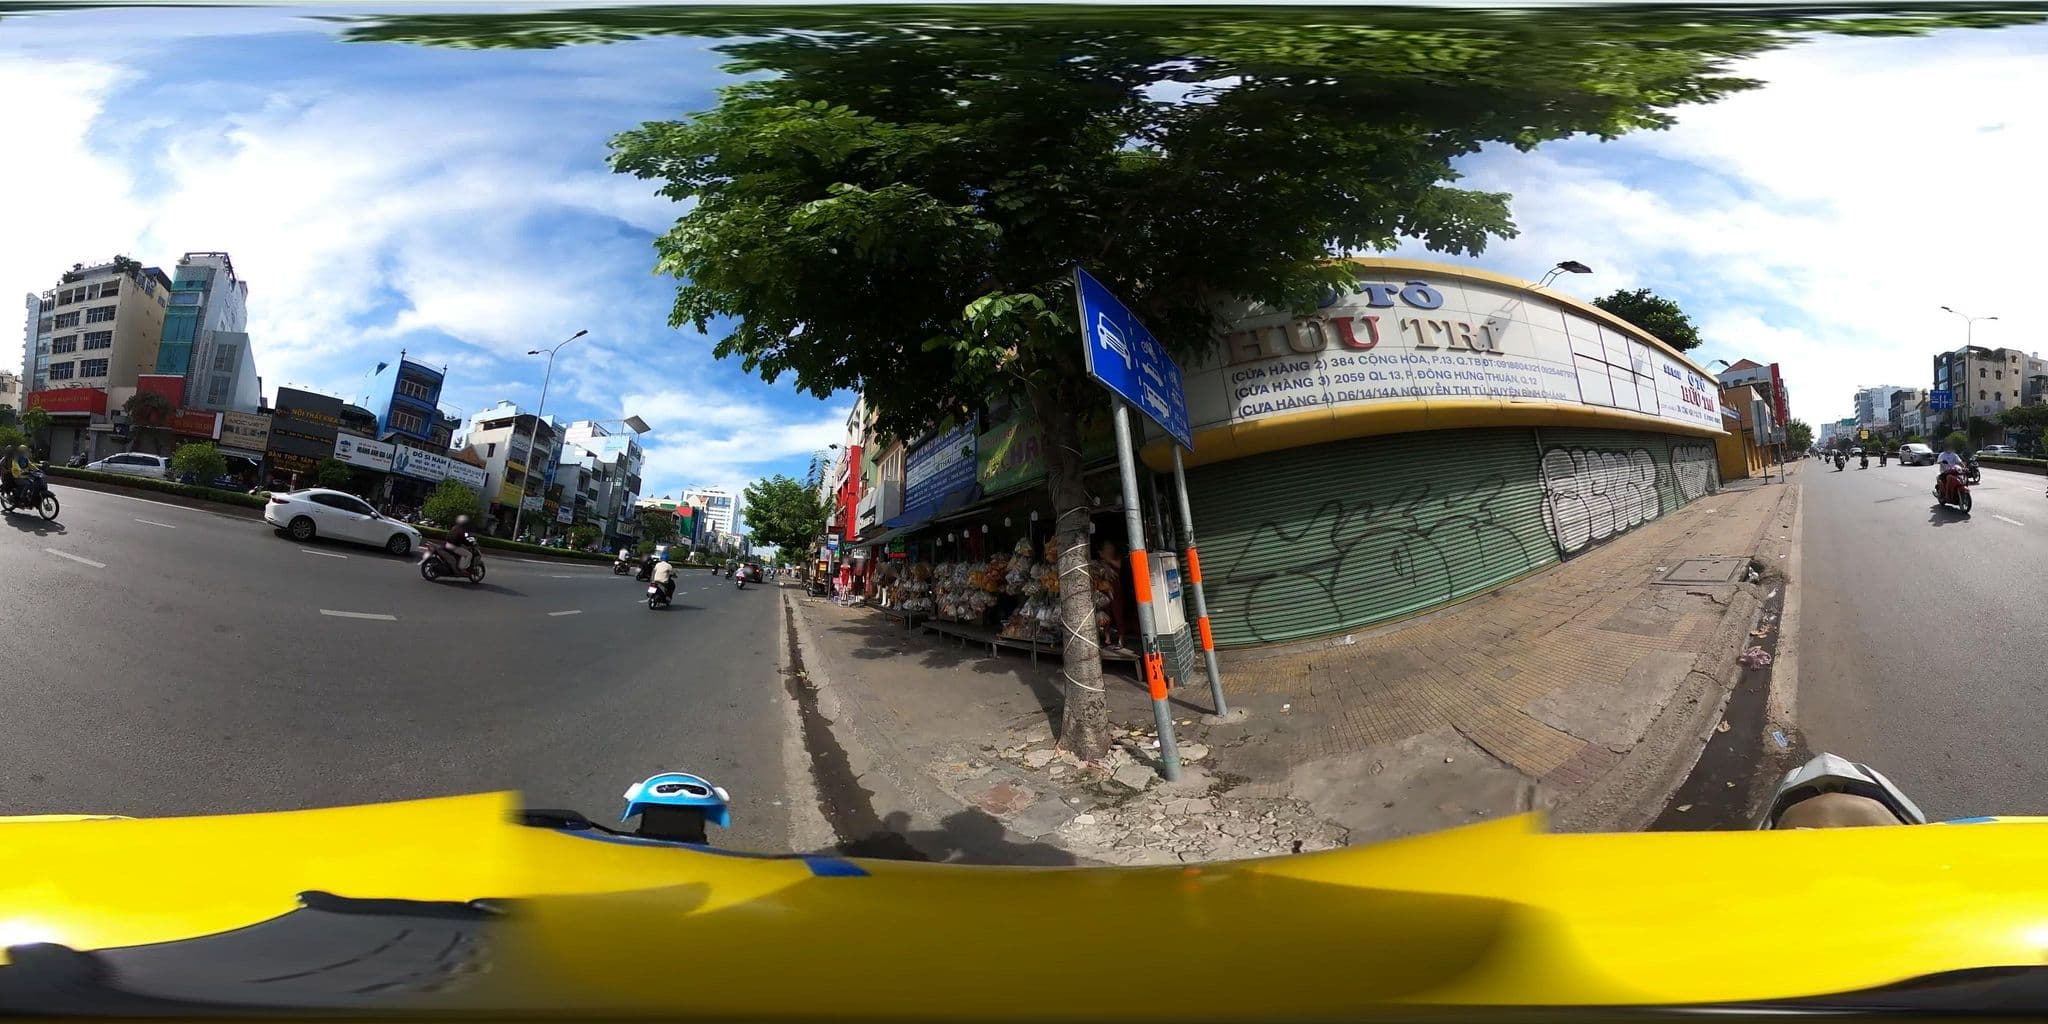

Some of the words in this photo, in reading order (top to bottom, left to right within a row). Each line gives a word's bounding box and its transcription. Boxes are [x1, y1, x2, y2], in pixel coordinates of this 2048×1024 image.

[1357, 280, 1443, 310] TÔ
[1401, 317, 1505, 356] TRÍ
[1269, 359, 1310, 376] HÀNG
[1314, 358, 1328, 370] 2)
[1331, 357, 1355, 368] 384
[1358, 353, 1398, 367] CỘNG
[1272, 376, 1313, 392] HÀNG
[1318, 375, 1330, 387] 3)
[1334, 372, 1365, 384] 2059
[1369, 371, 1387, 382] QL
[1455, 371, 1484, 381] HƯNG
[1276, 394, 1317, 411] HÀNG
[1322, 392, 1334, 405] 4)
[1337, 387, 1398, 401] D6/14/14A
[1401, 382, 1450, 396] NGUYỄN
